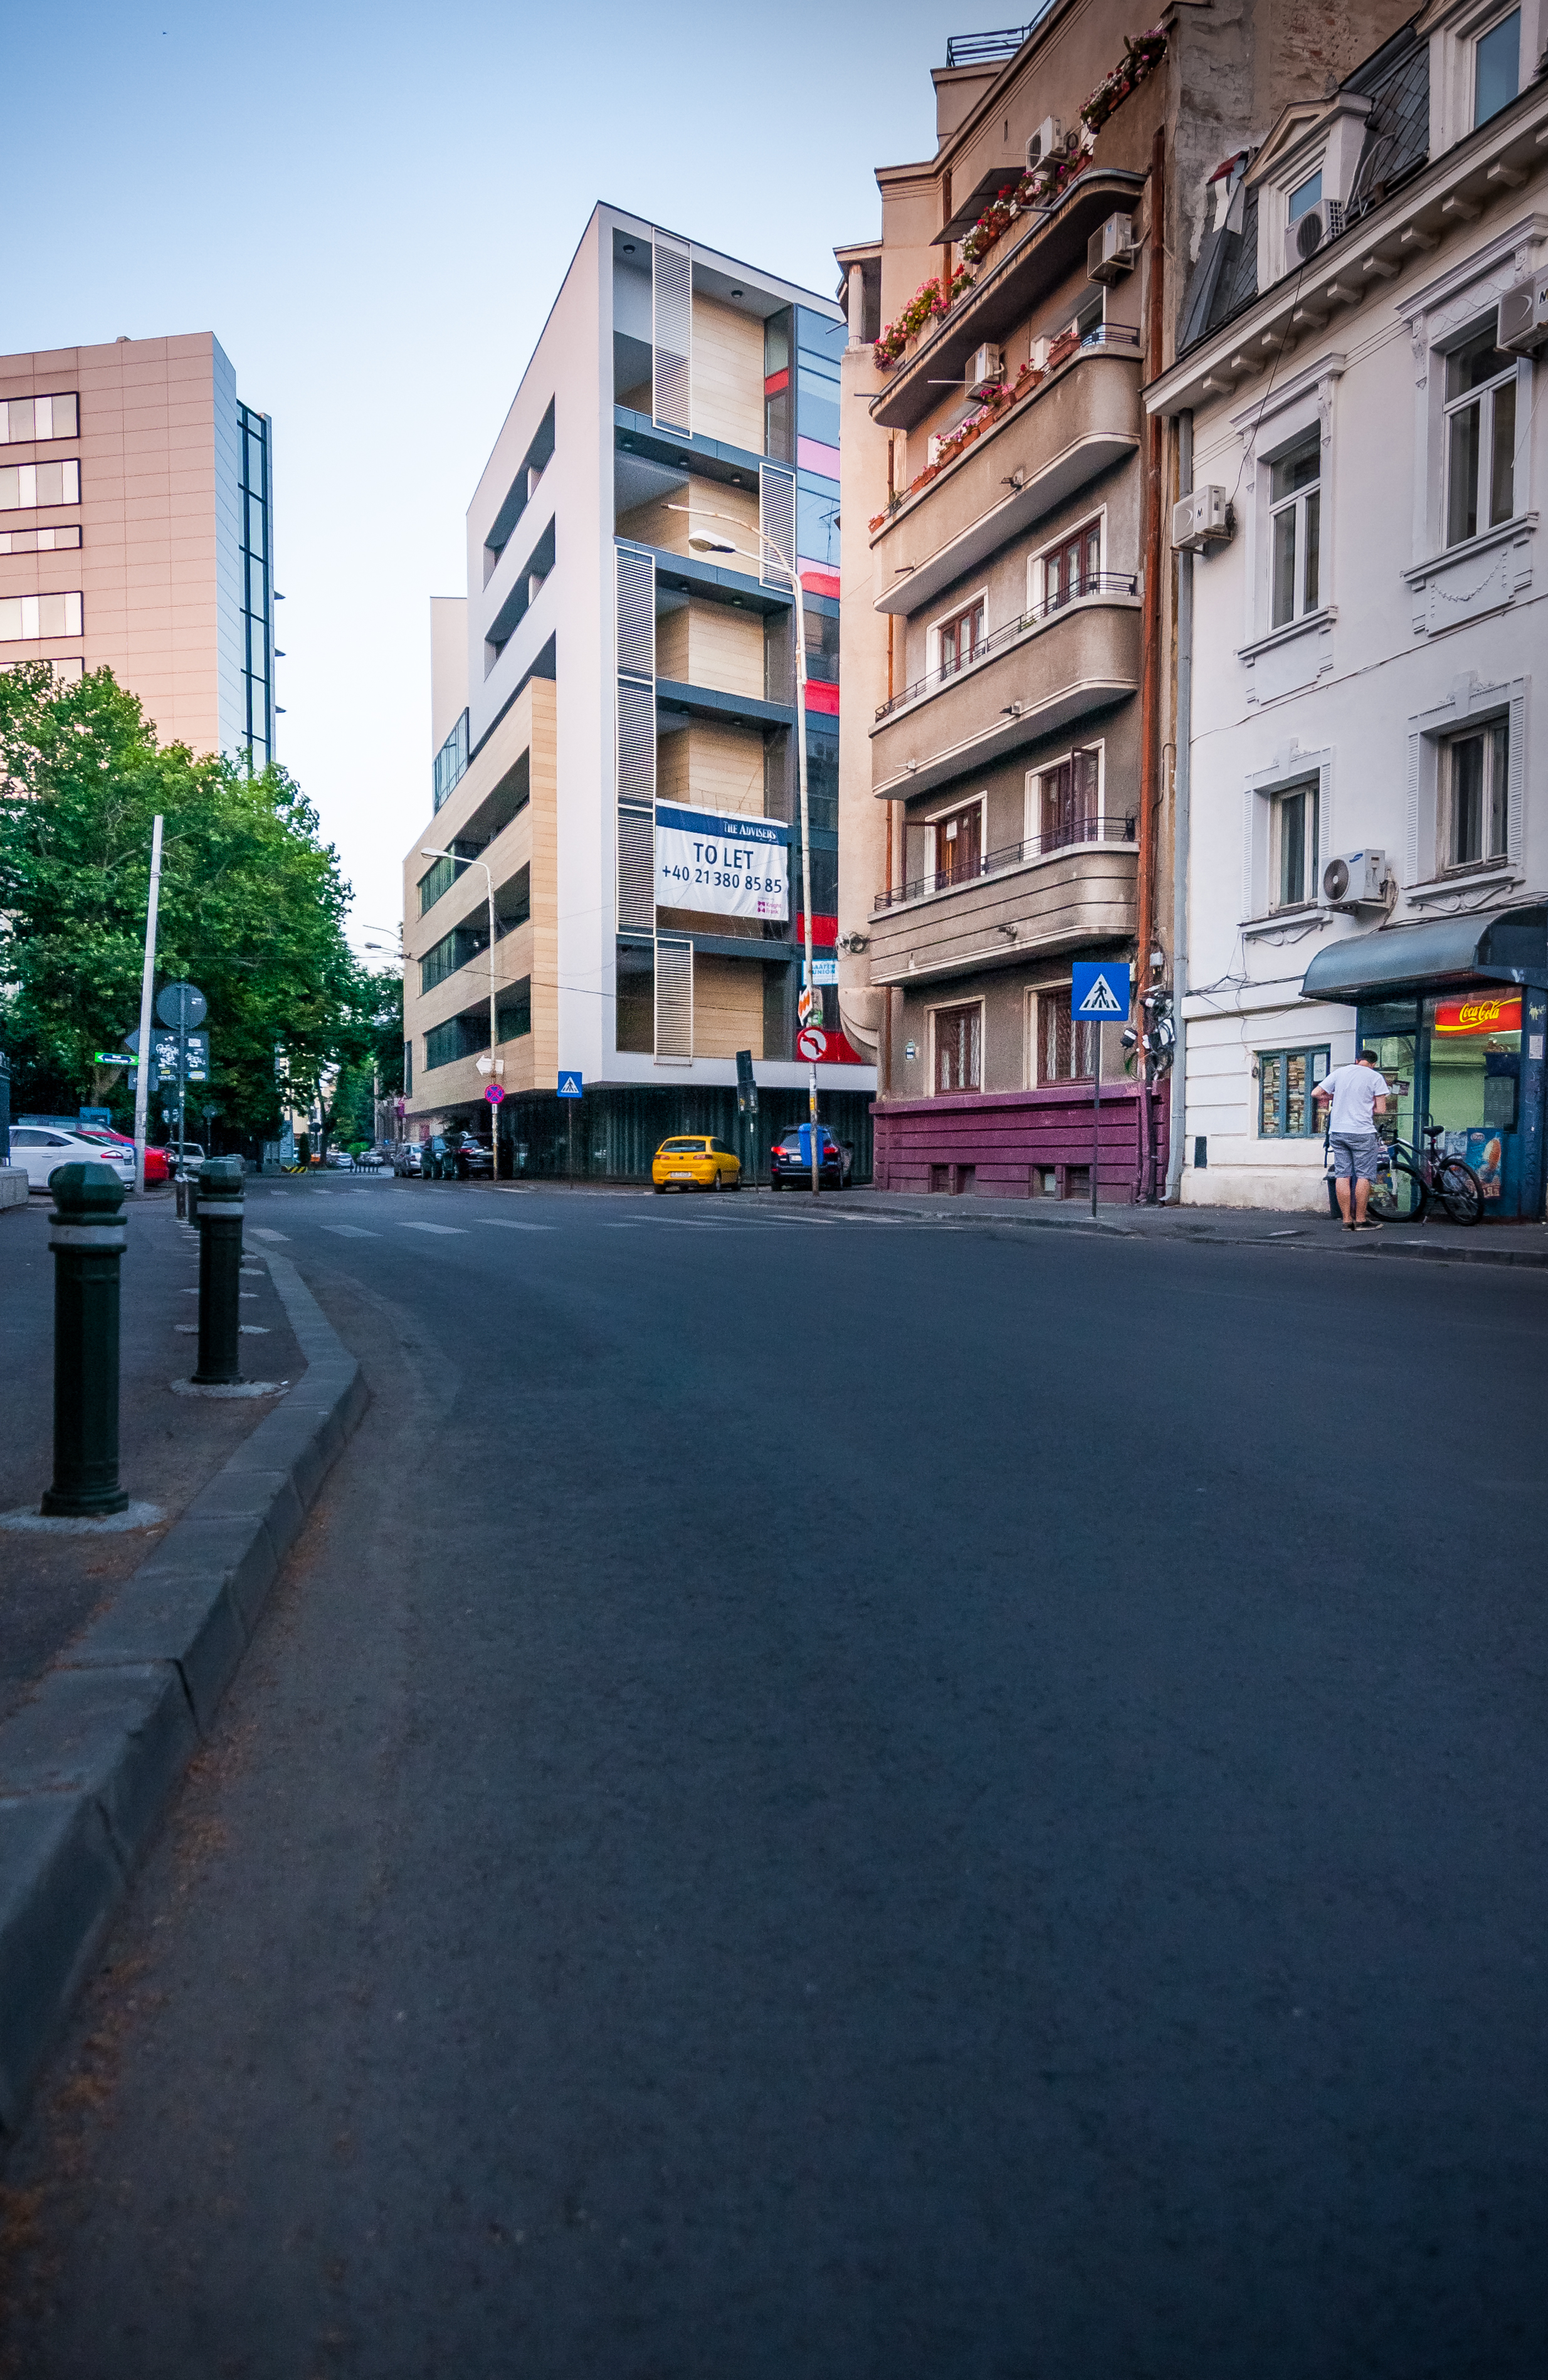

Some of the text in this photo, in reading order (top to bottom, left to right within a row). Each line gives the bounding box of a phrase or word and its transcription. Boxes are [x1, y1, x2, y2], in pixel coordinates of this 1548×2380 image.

[724, 821, 776, 840] THE ADVISERS
[693, 842, 754, 870] TO LET
[662, 865, 690, 882] +40
[745, 875, 761, 891] 85
[765, 878, 782, 893] 85
